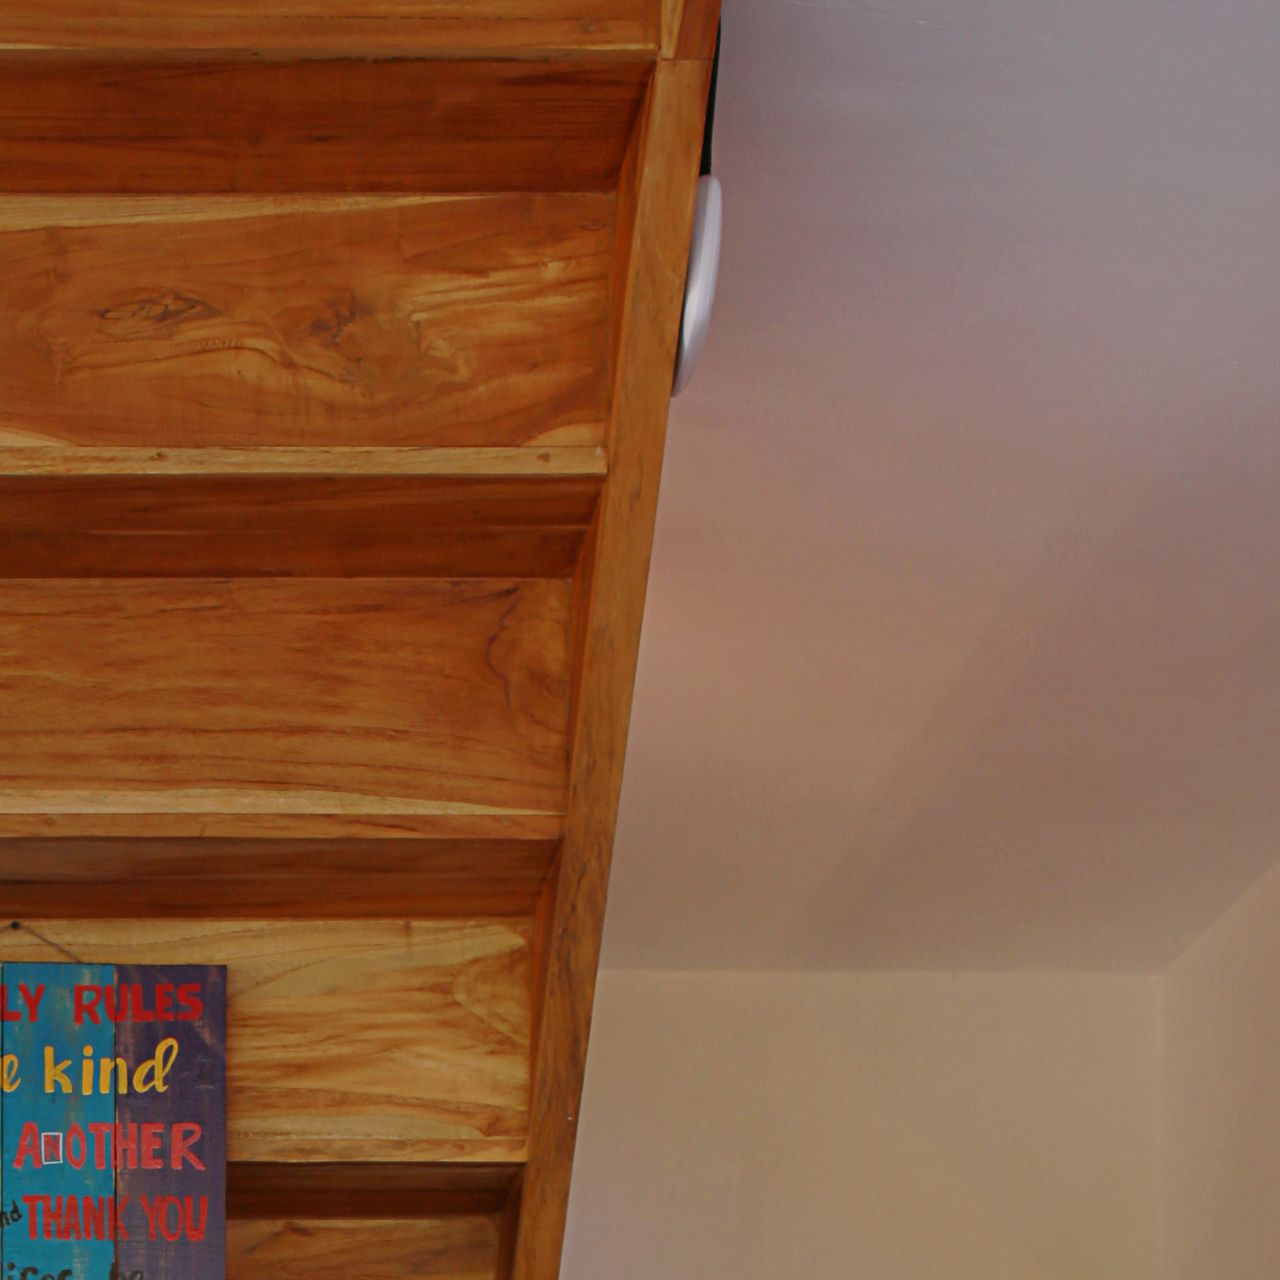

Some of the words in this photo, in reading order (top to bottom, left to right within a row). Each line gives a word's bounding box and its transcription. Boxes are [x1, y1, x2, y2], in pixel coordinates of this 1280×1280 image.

[73, 982, 204, 1025] RULES
[43, 1038, 180, 1096] kind
[12, 1121, 206, 1171] ANOTHER
[21, 1194, 130, 1241] THANK
[141, 1195, 209, 1242] YOU
